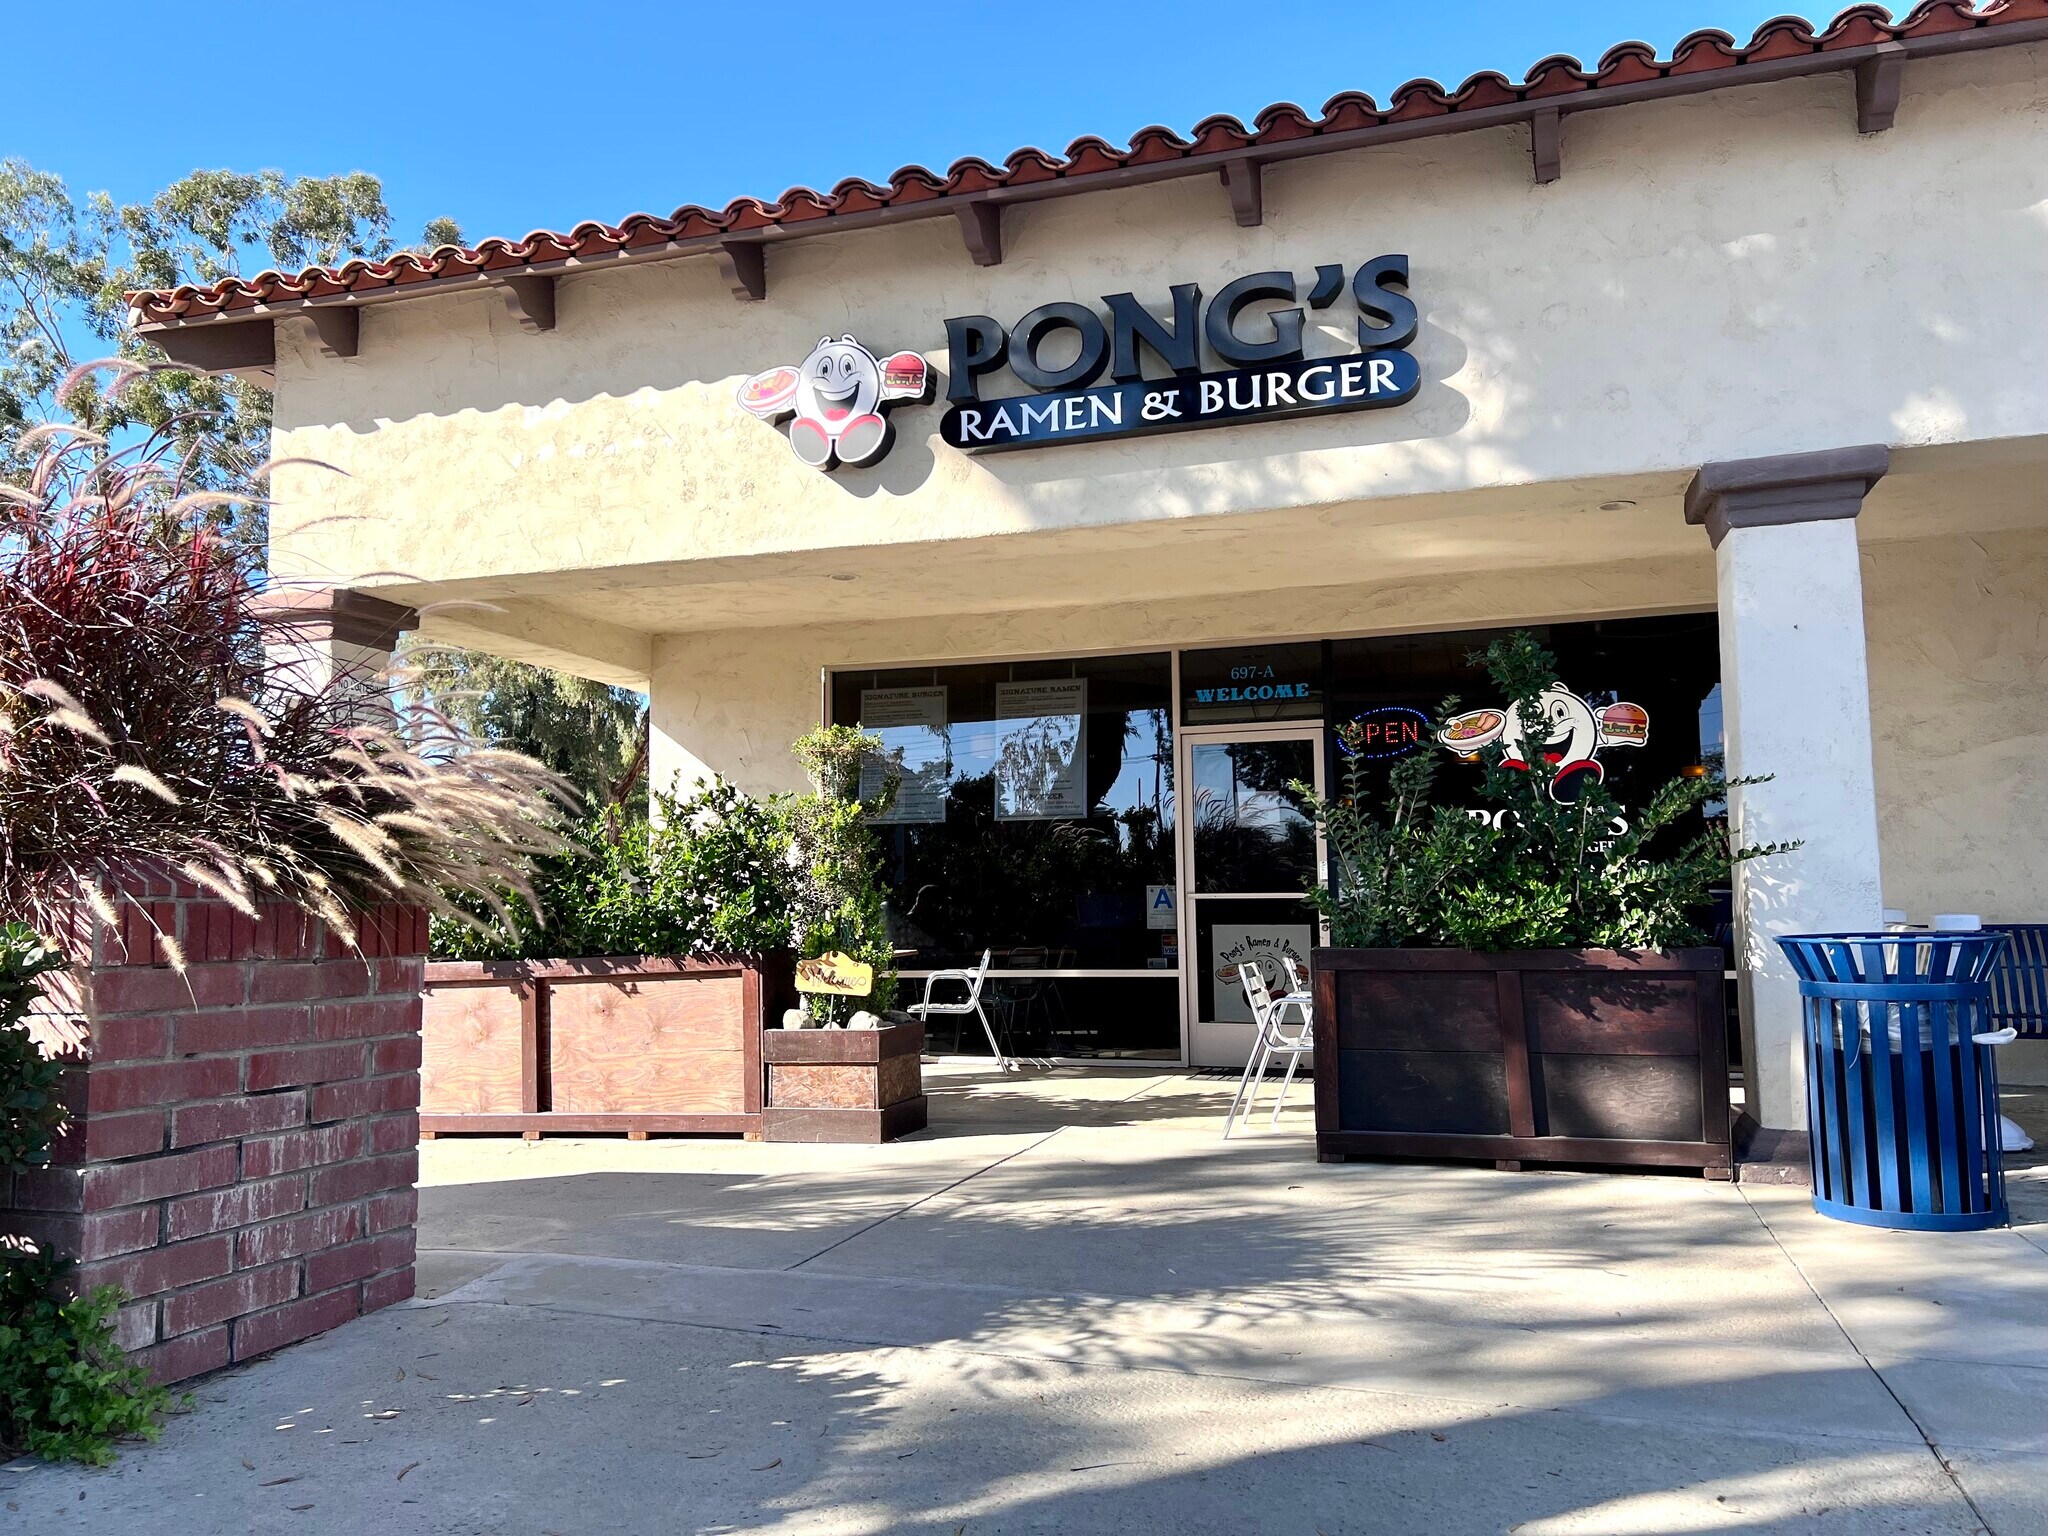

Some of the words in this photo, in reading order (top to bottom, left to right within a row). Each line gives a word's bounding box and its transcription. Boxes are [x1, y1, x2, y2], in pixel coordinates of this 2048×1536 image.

[944, 253, 1418, 401] PONG'S
[959, 388, 1124, 443] RAMEN
[1140, 391, 1182, 421] &
[1199, 359, 1399, 414] BURGER
[1230, 665, 1275, 680] 697-A
[864, 692, 909, 701] SIGNATURE
[911, 690, 945, 698] BURGER
[1000, 687, 1047, 696] SIGNATURE
[1050, 685, 1081, 693] RAMEN
[1195, 683, 1309, 703] WELCOME
[1153, 888, 1173, 909] A
[1219, 942, 1246, 964] Pong's
[1245, 935, 1272, 951] Ramen
[1273, 937, 1280, 949] &
[1281, 938, 1303, 963] Burger
